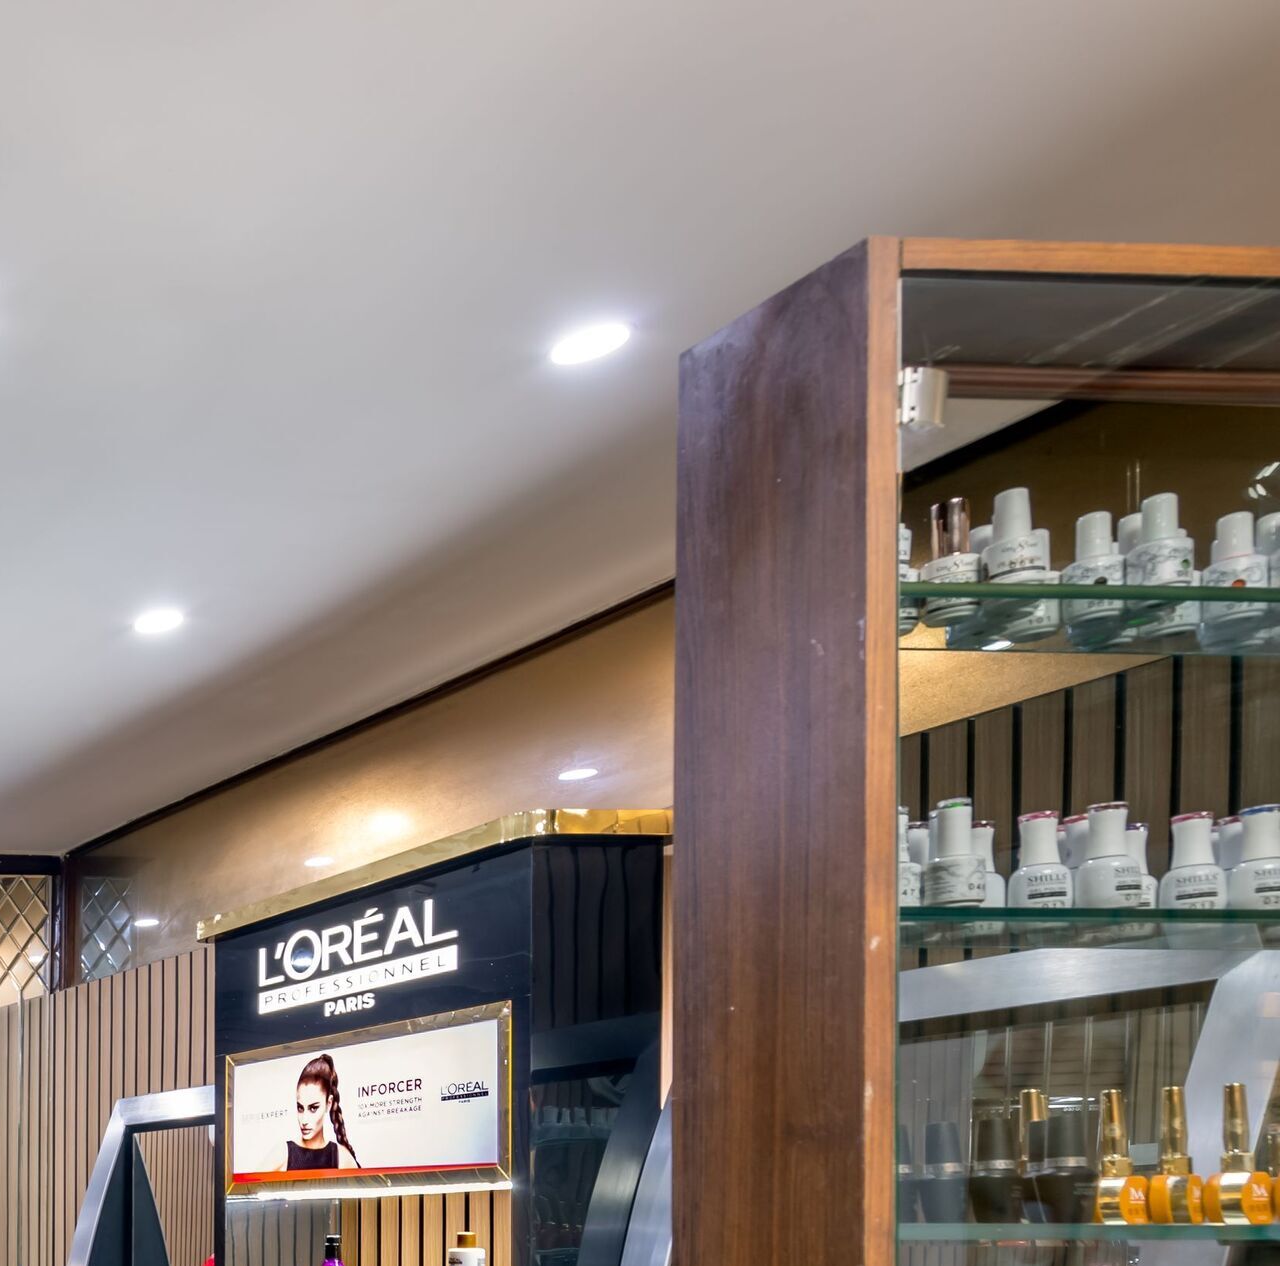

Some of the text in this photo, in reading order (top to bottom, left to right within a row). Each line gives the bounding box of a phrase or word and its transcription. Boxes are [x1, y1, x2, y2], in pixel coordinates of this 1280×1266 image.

[258, 898, 459, 988] L'ORÉAL
[263, 952, 449, 1008] PROFESSIONNEL
[323, 992, 376, 1018] PARIS
[357, 1078, 423, 1098] INFORCER
[358, 1105, 422, 1118] AGAINST BREAKAGE
[388, 1097, 423, 1107] STRENGTH
